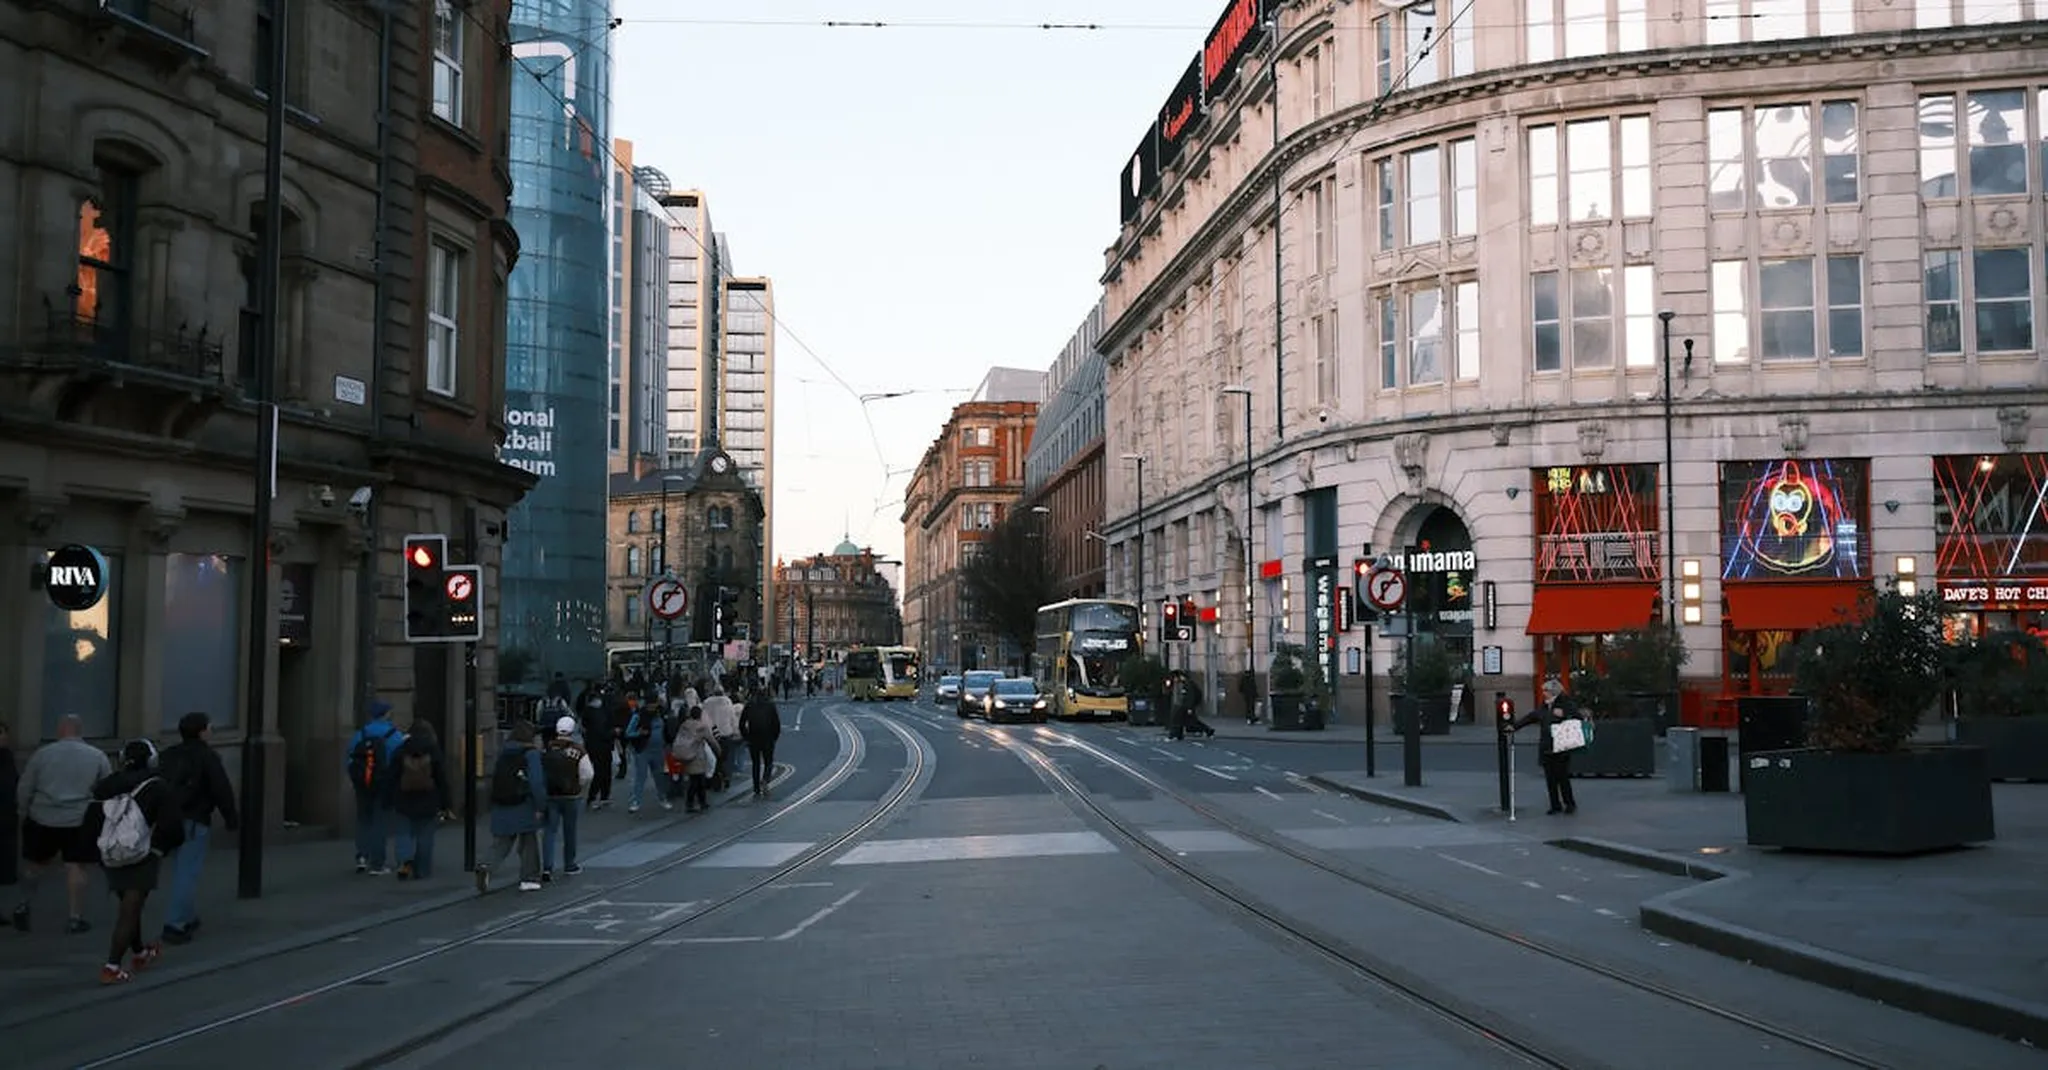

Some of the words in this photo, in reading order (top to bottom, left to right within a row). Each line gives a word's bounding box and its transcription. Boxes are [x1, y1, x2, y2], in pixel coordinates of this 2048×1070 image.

[500, 458, 555, 476] eum
[51, 566, 96, 586] RIVA
[1943, 587, 1989, 601] DAVE'S
[1995, 587, 2021, 600] HOT
